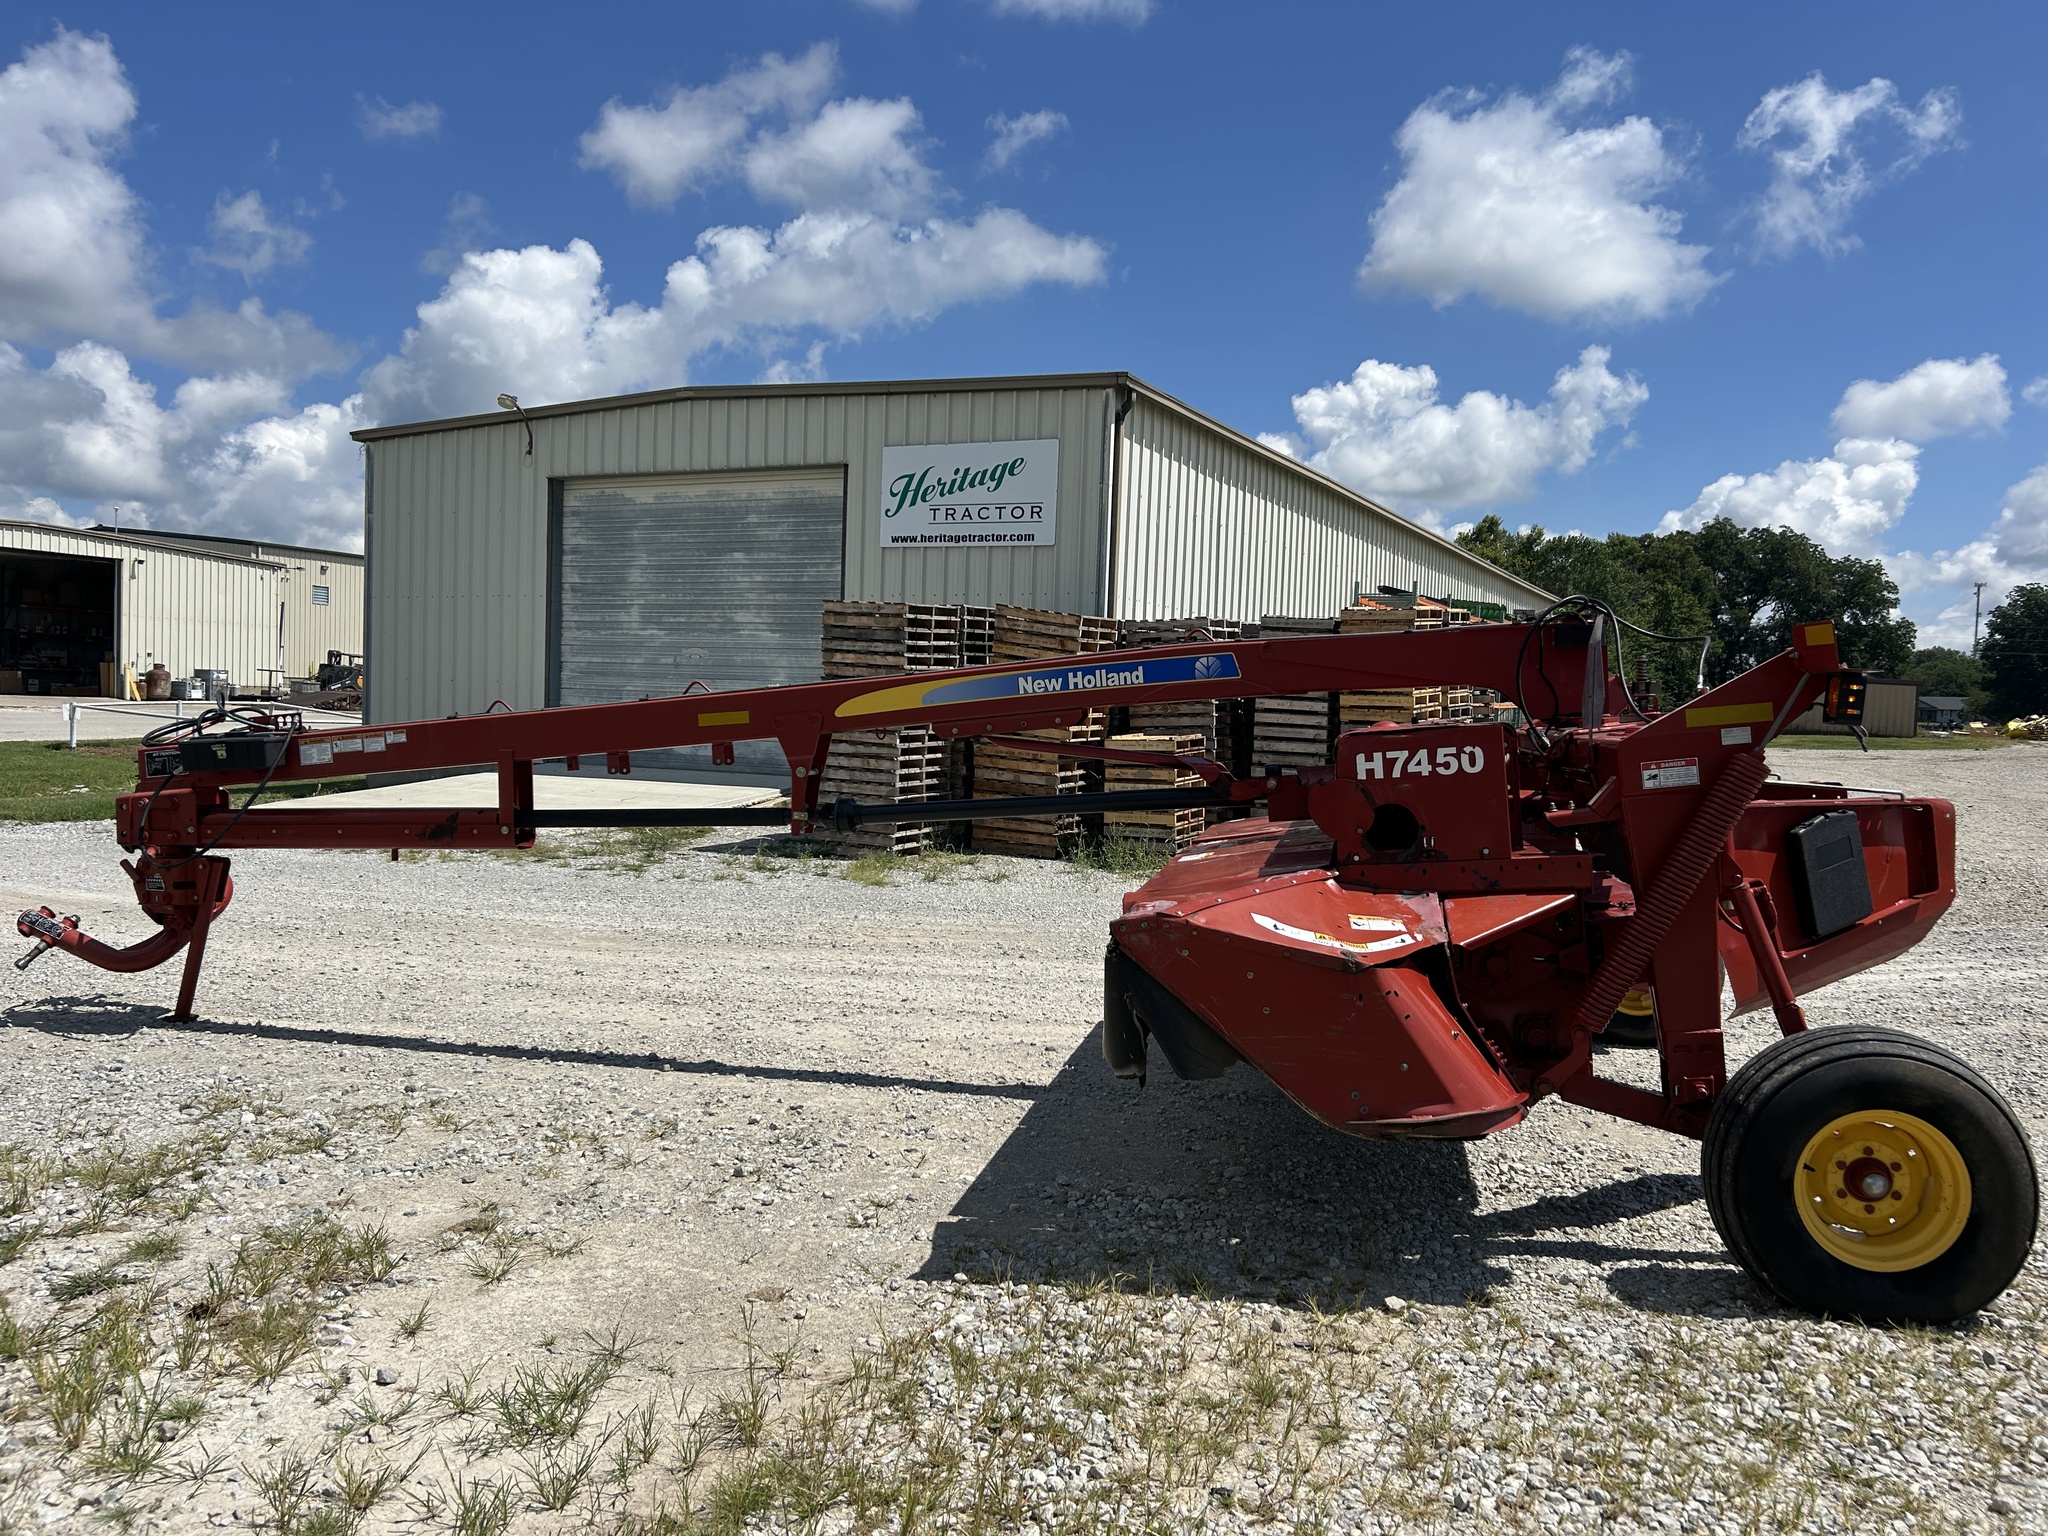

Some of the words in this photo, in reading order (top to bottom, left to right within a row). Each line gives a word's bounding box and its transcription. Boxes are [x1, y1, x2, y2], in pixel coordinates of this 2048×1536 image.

[884, 457, 1027, 518] Heritage
[929, 505, 1043, 521] TRACTOR
[890, 533, 1035, 544] www.heritagetractor.com
[1017, 676, 1062, 695] New
[1067, 665, 1144, 690] Holland
[1355, 745, 1485, 780] H7450
[1660, 760, 1686, 768] DANGER
